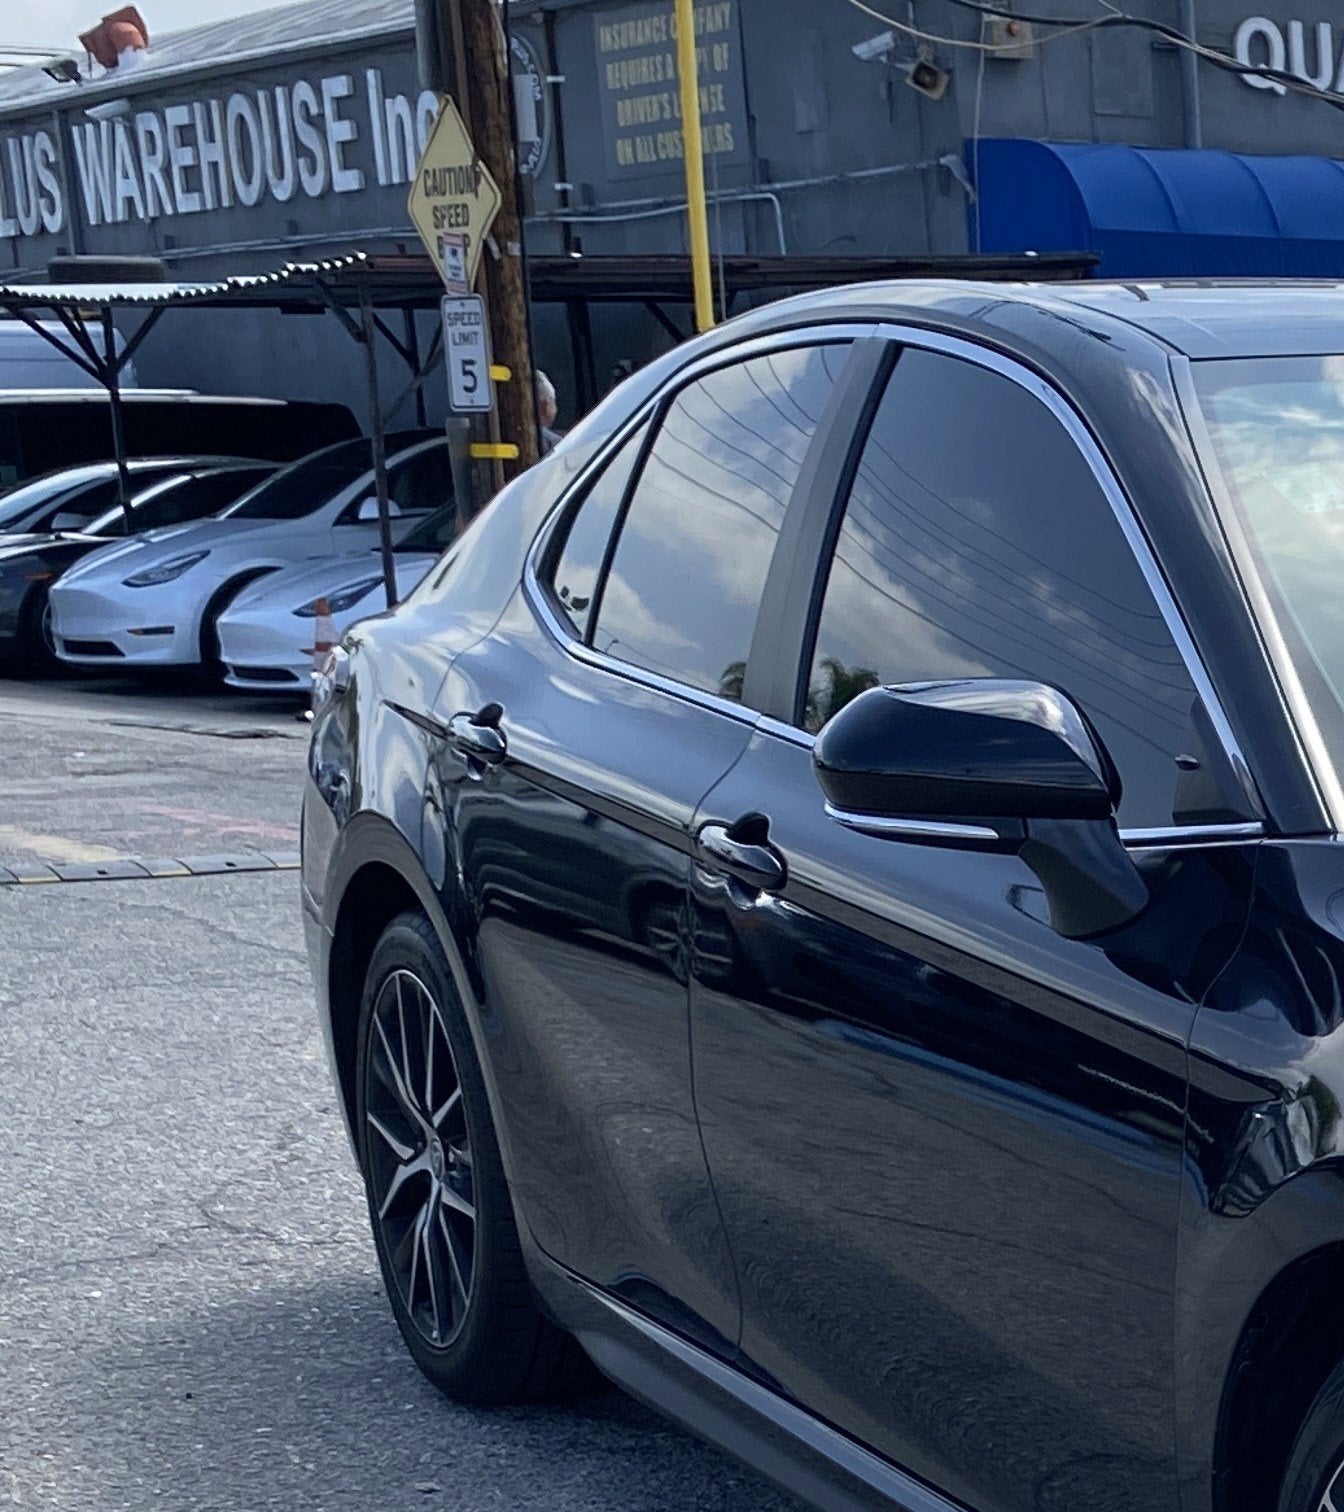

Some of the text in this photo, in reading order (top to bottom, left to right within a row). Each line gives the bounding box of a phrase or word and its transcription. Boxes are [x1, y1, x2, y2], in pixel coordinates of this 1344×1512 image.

[601, 14, 667, 52] INSURANCE
[606, 54, 664, 90] REQUIRES
[72, 75, 365, 226] WAREHOUSE
[616, 138, 635, 166] ON
[635, 135, 657, 163] ALL
[433, 204, 470, 229] SPEED
[447, 311, 481, 328] SPEED
[451, 331, 479, 347] LIMIT
[461, 358, 478, 394] 5
